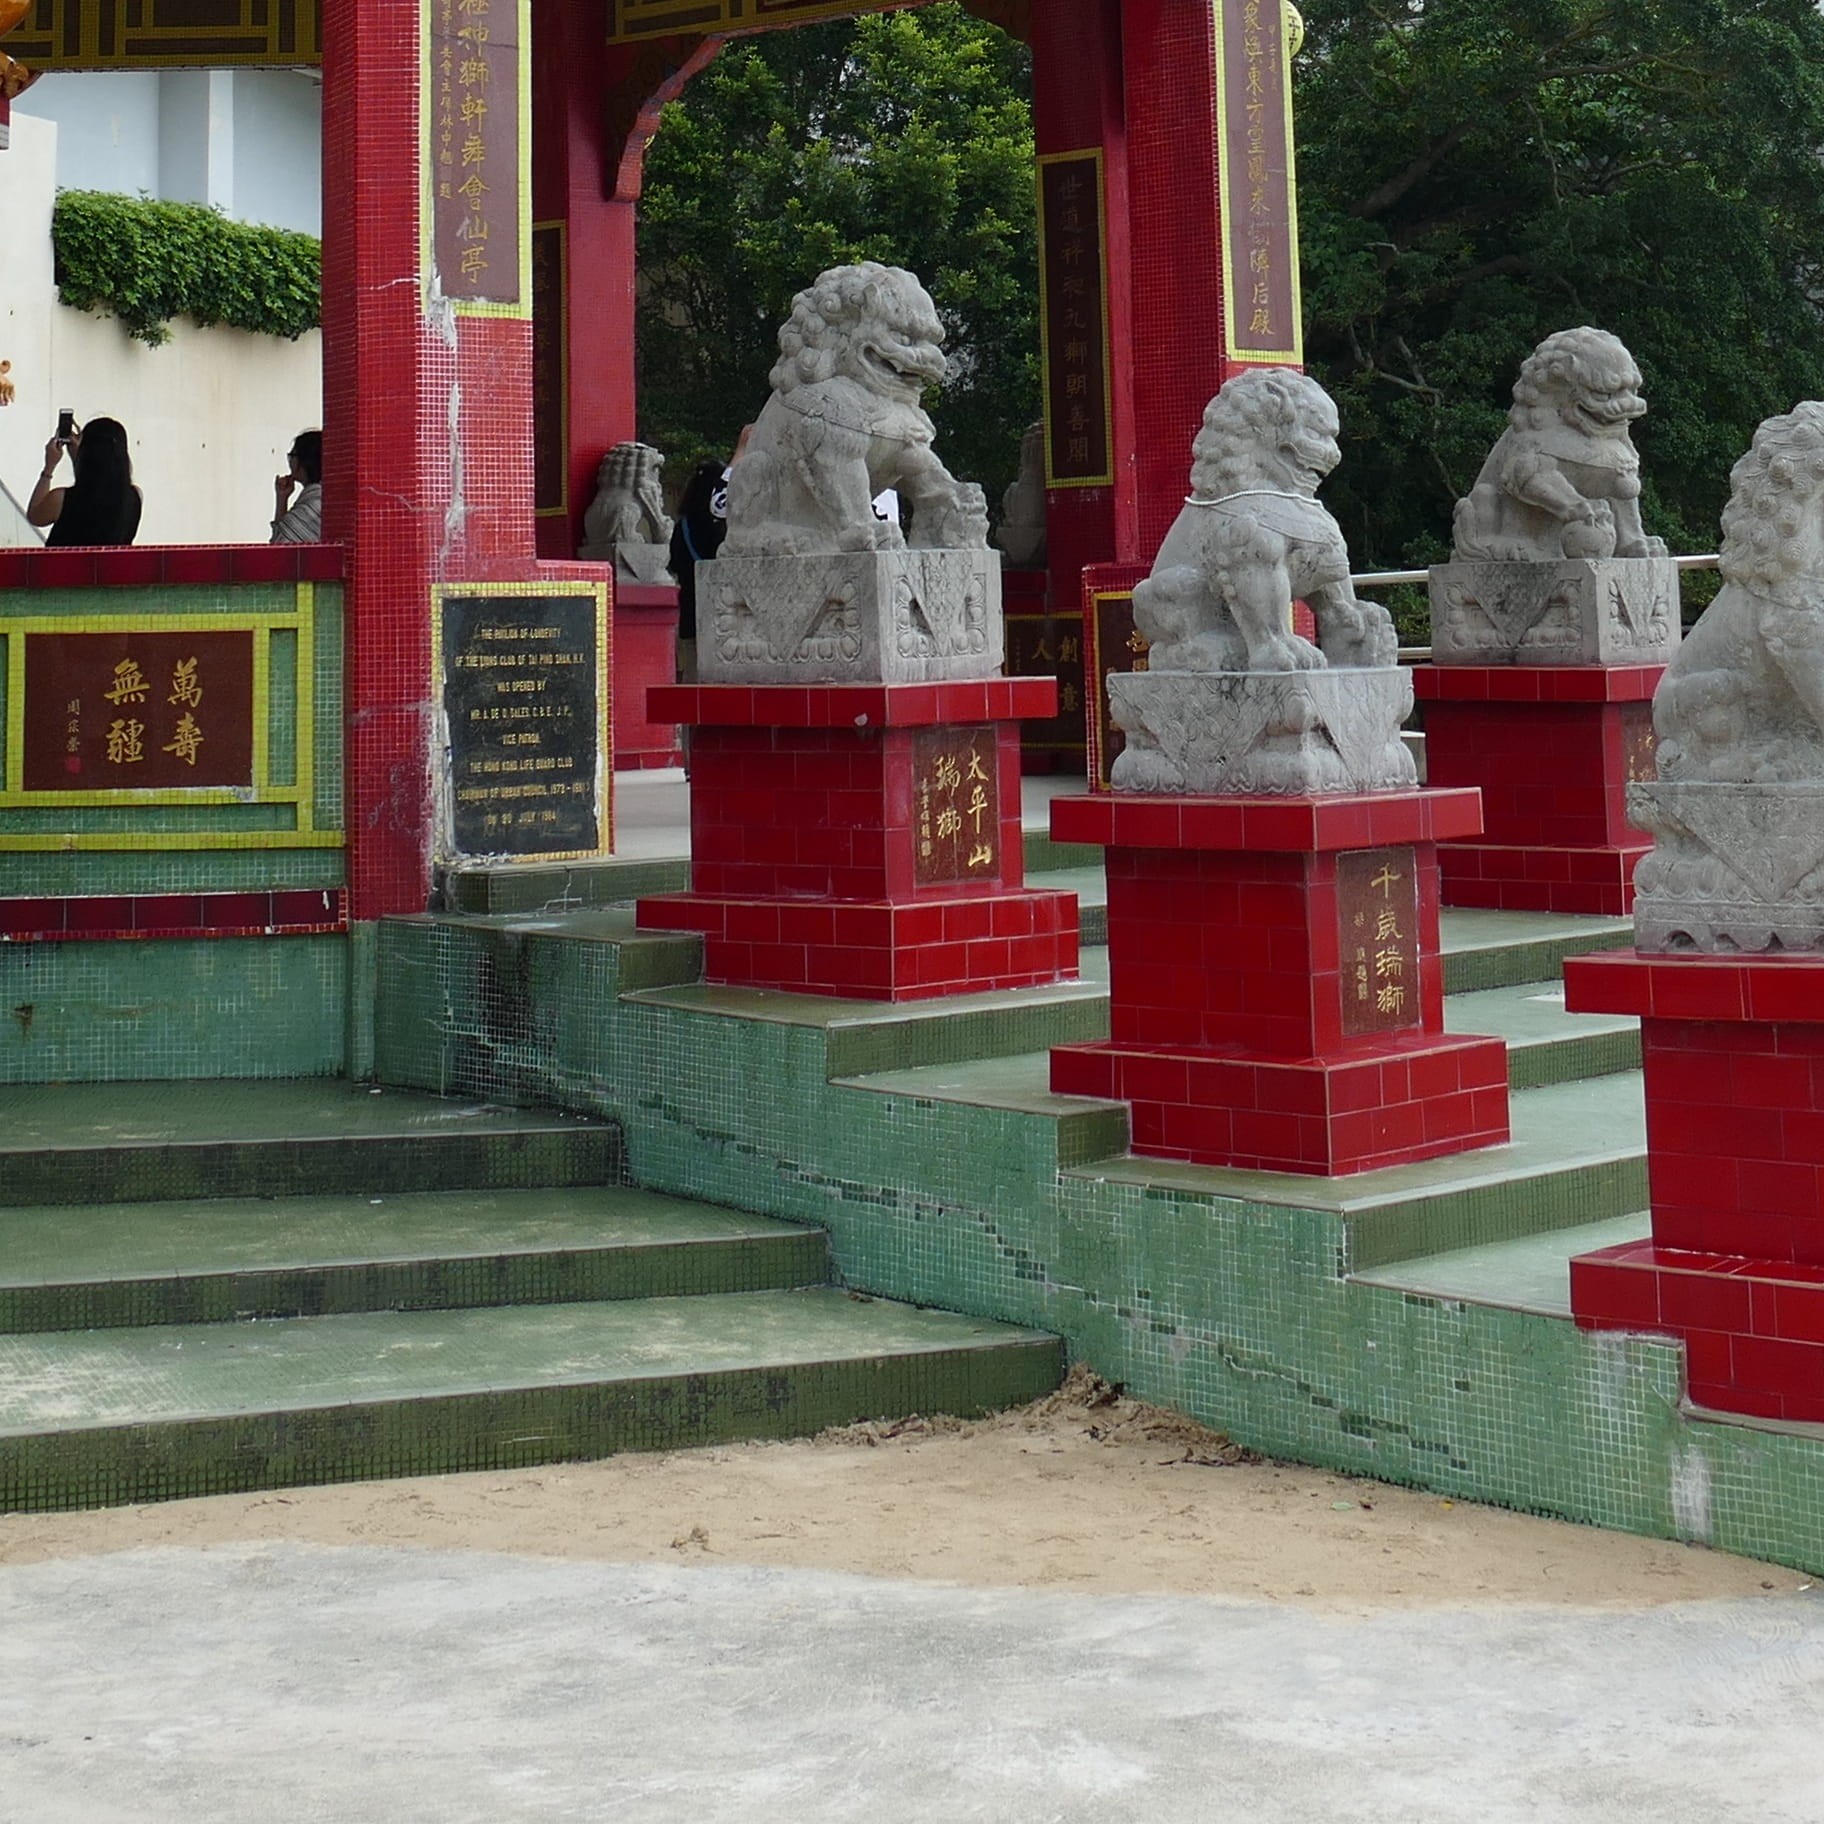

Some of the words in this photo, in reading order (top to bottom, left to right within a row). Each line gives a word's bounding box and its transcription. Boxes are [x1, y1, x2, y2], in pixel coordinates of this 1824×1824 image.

[103, 657, 151, 764] 無疆
[161, 655, 205, 766] 萬壽
[557, 756, 573, 768] CLUB
[966, 748, 993, 867] 太平山
[1370, 863, 1405, 1016] 千歲瑞獅
